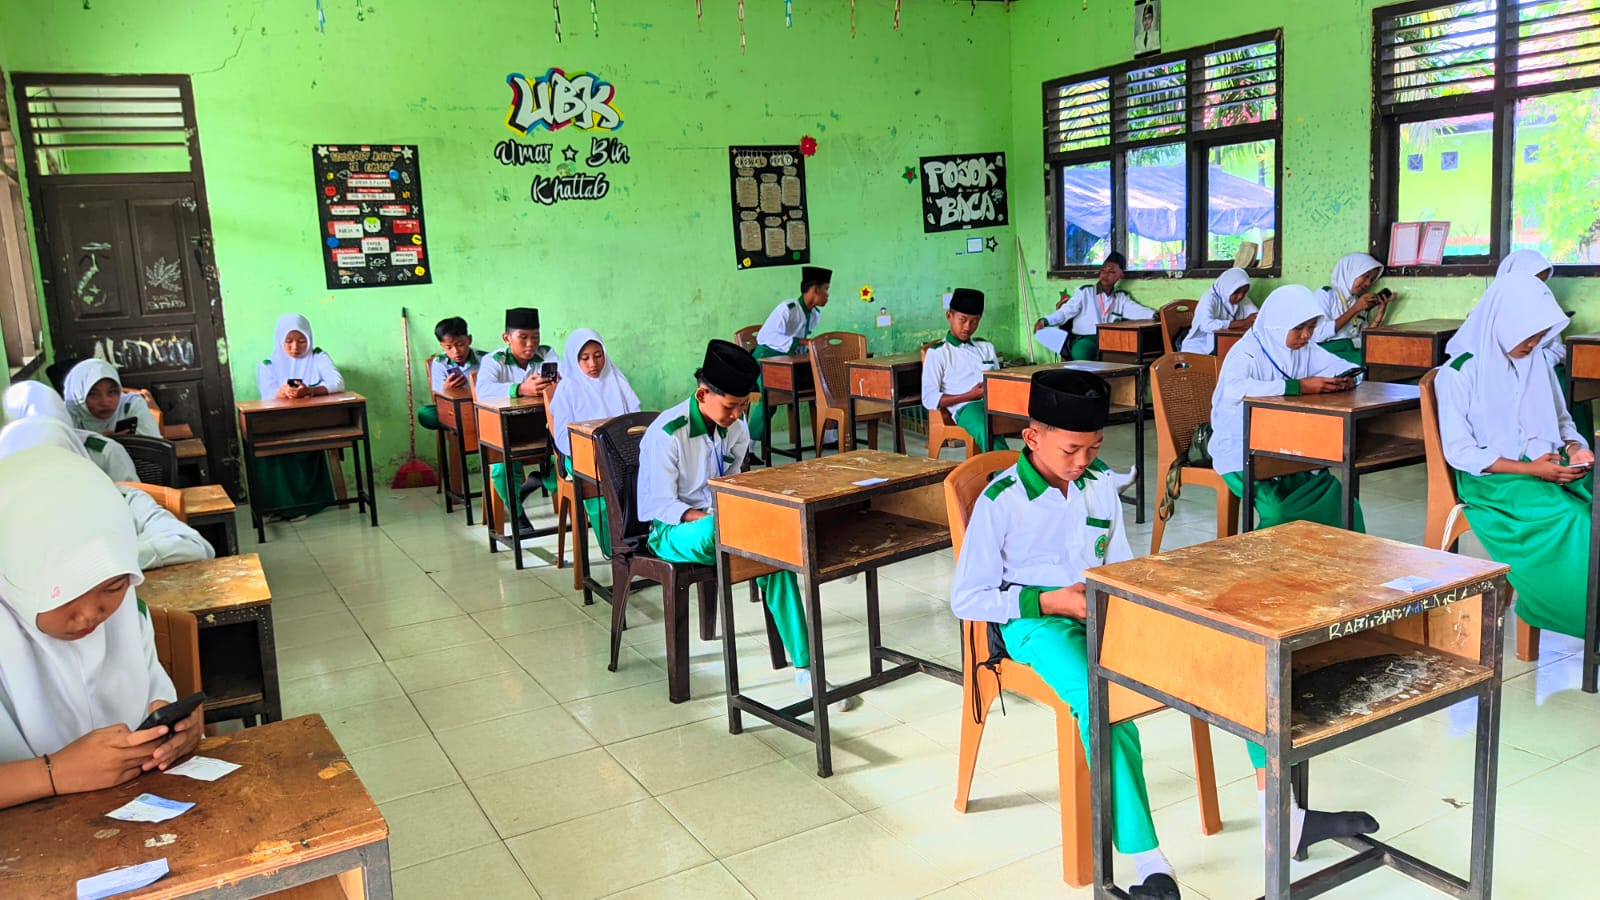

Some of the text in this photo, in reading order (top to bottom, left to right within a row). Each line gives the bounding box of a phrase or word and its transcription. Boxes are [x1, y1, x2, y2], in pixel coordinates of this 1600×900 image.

[494, 137, 630, 167] Umar Bin
[531, 173, 609, 205] Khattab
[923, 156, 998, 193] POJOK
[935, 190, 995, 227] BACA
